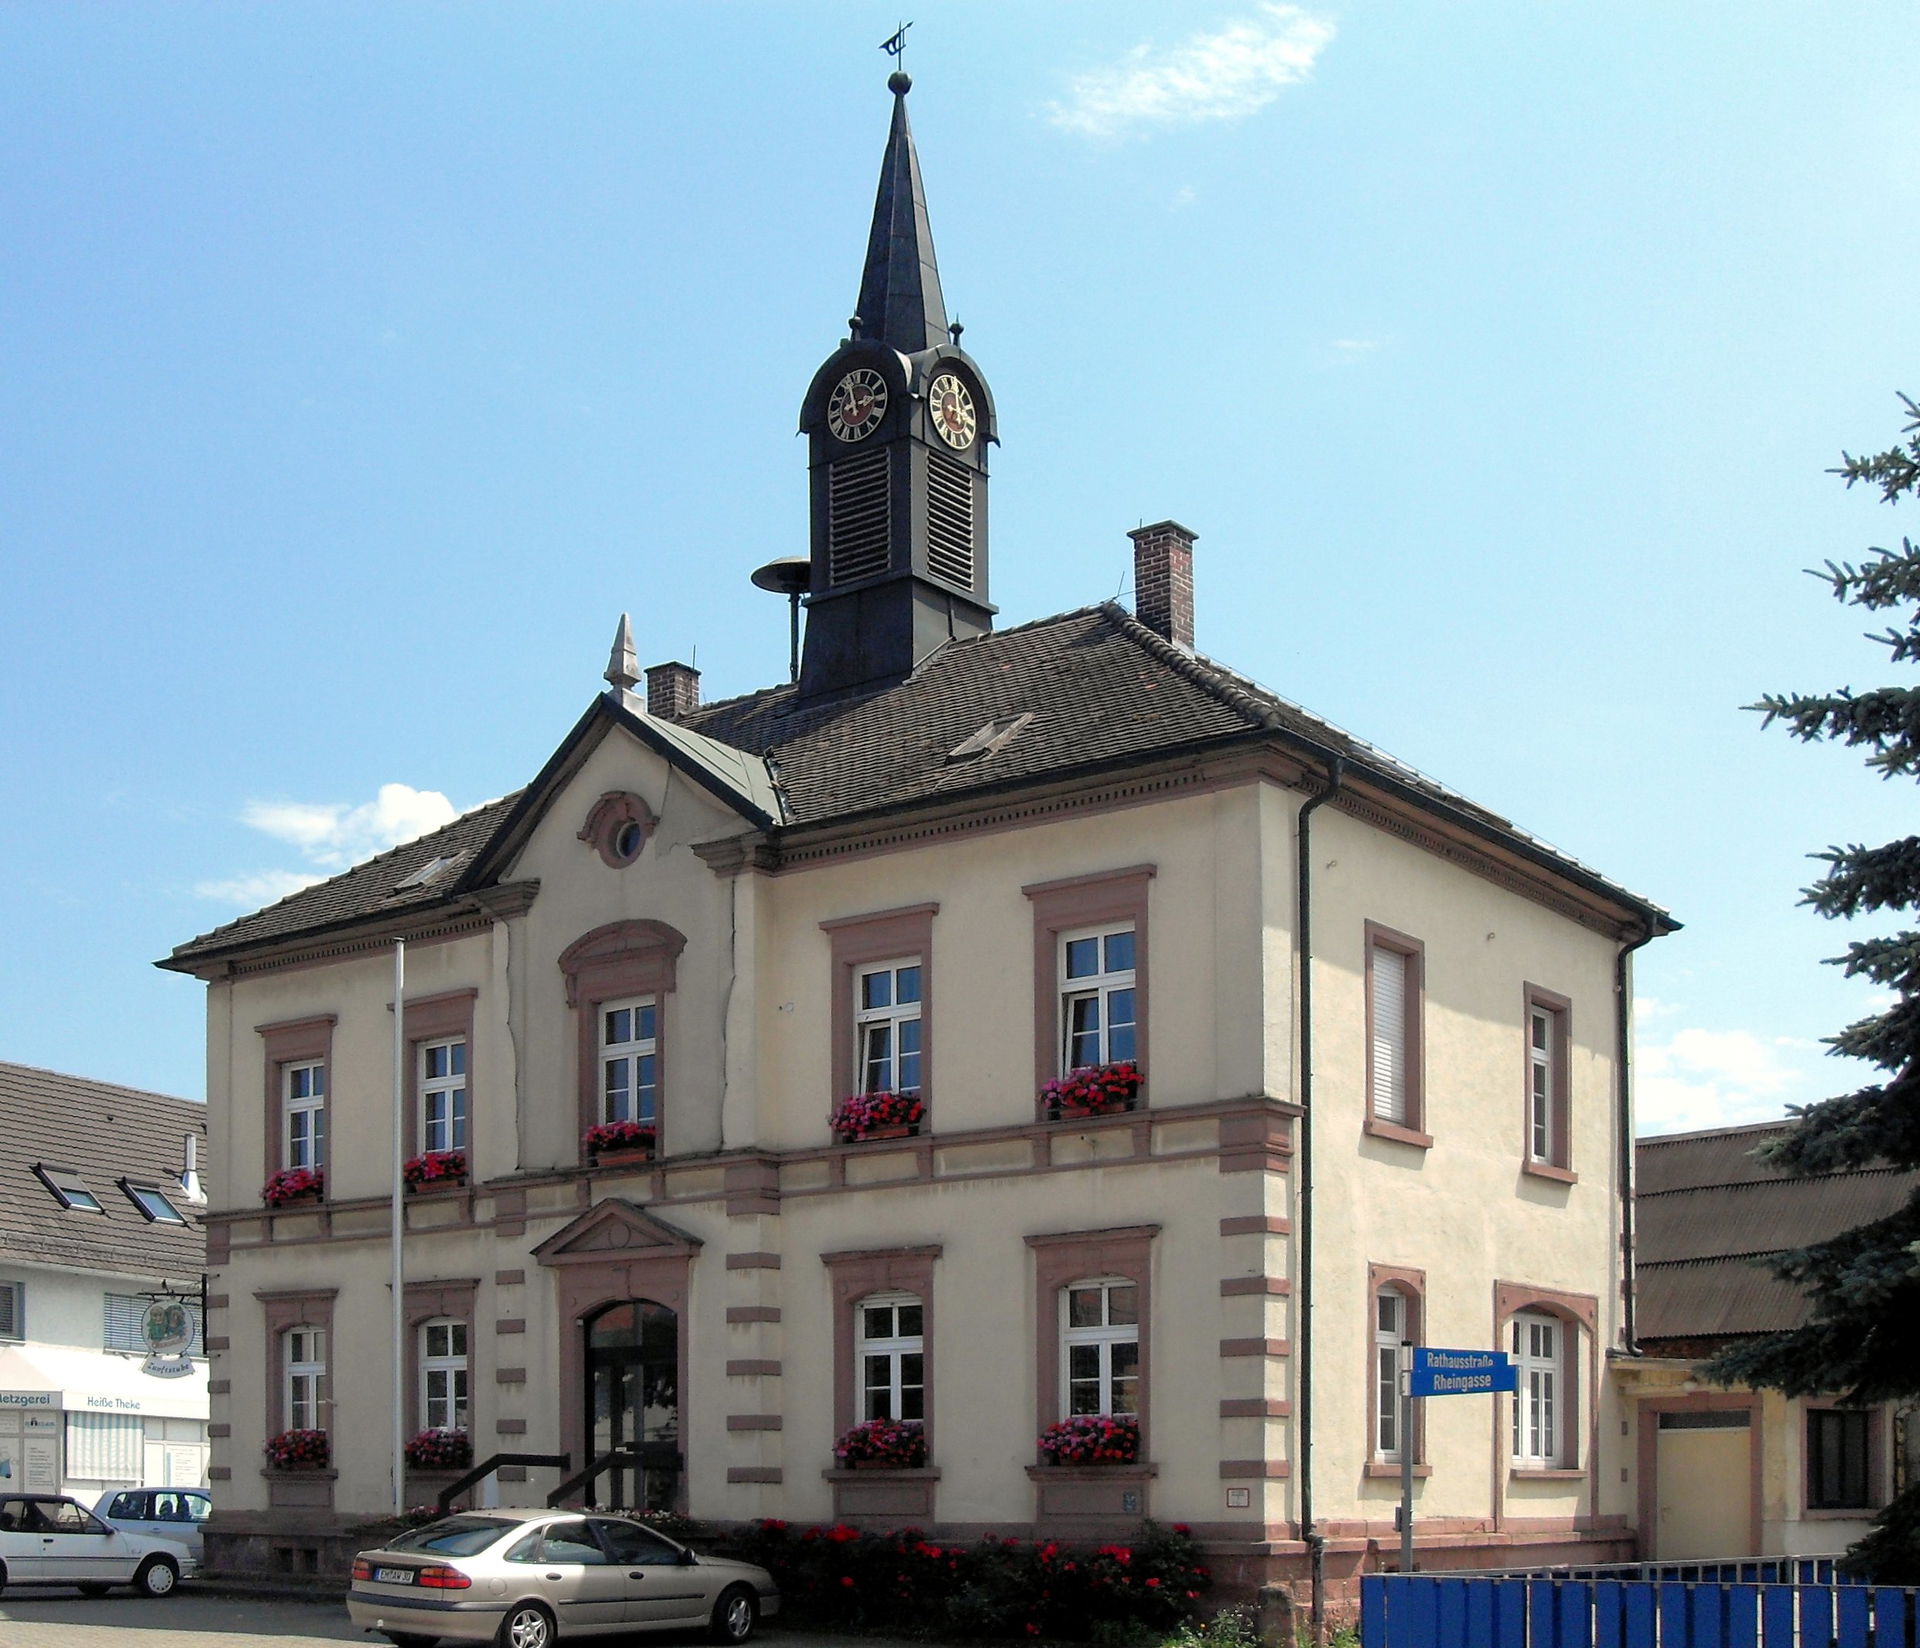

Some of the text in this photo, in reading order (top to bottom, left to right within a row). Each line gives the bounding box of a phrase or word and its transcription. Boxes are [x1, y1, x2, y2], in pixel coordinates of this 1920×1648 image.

[1427, 1352, 1494, 1369] Rathausstraße
[1433, 1374, 1491, 1392] Rheingasse
[87, 1396, 141, 1409] Heiße Theke
